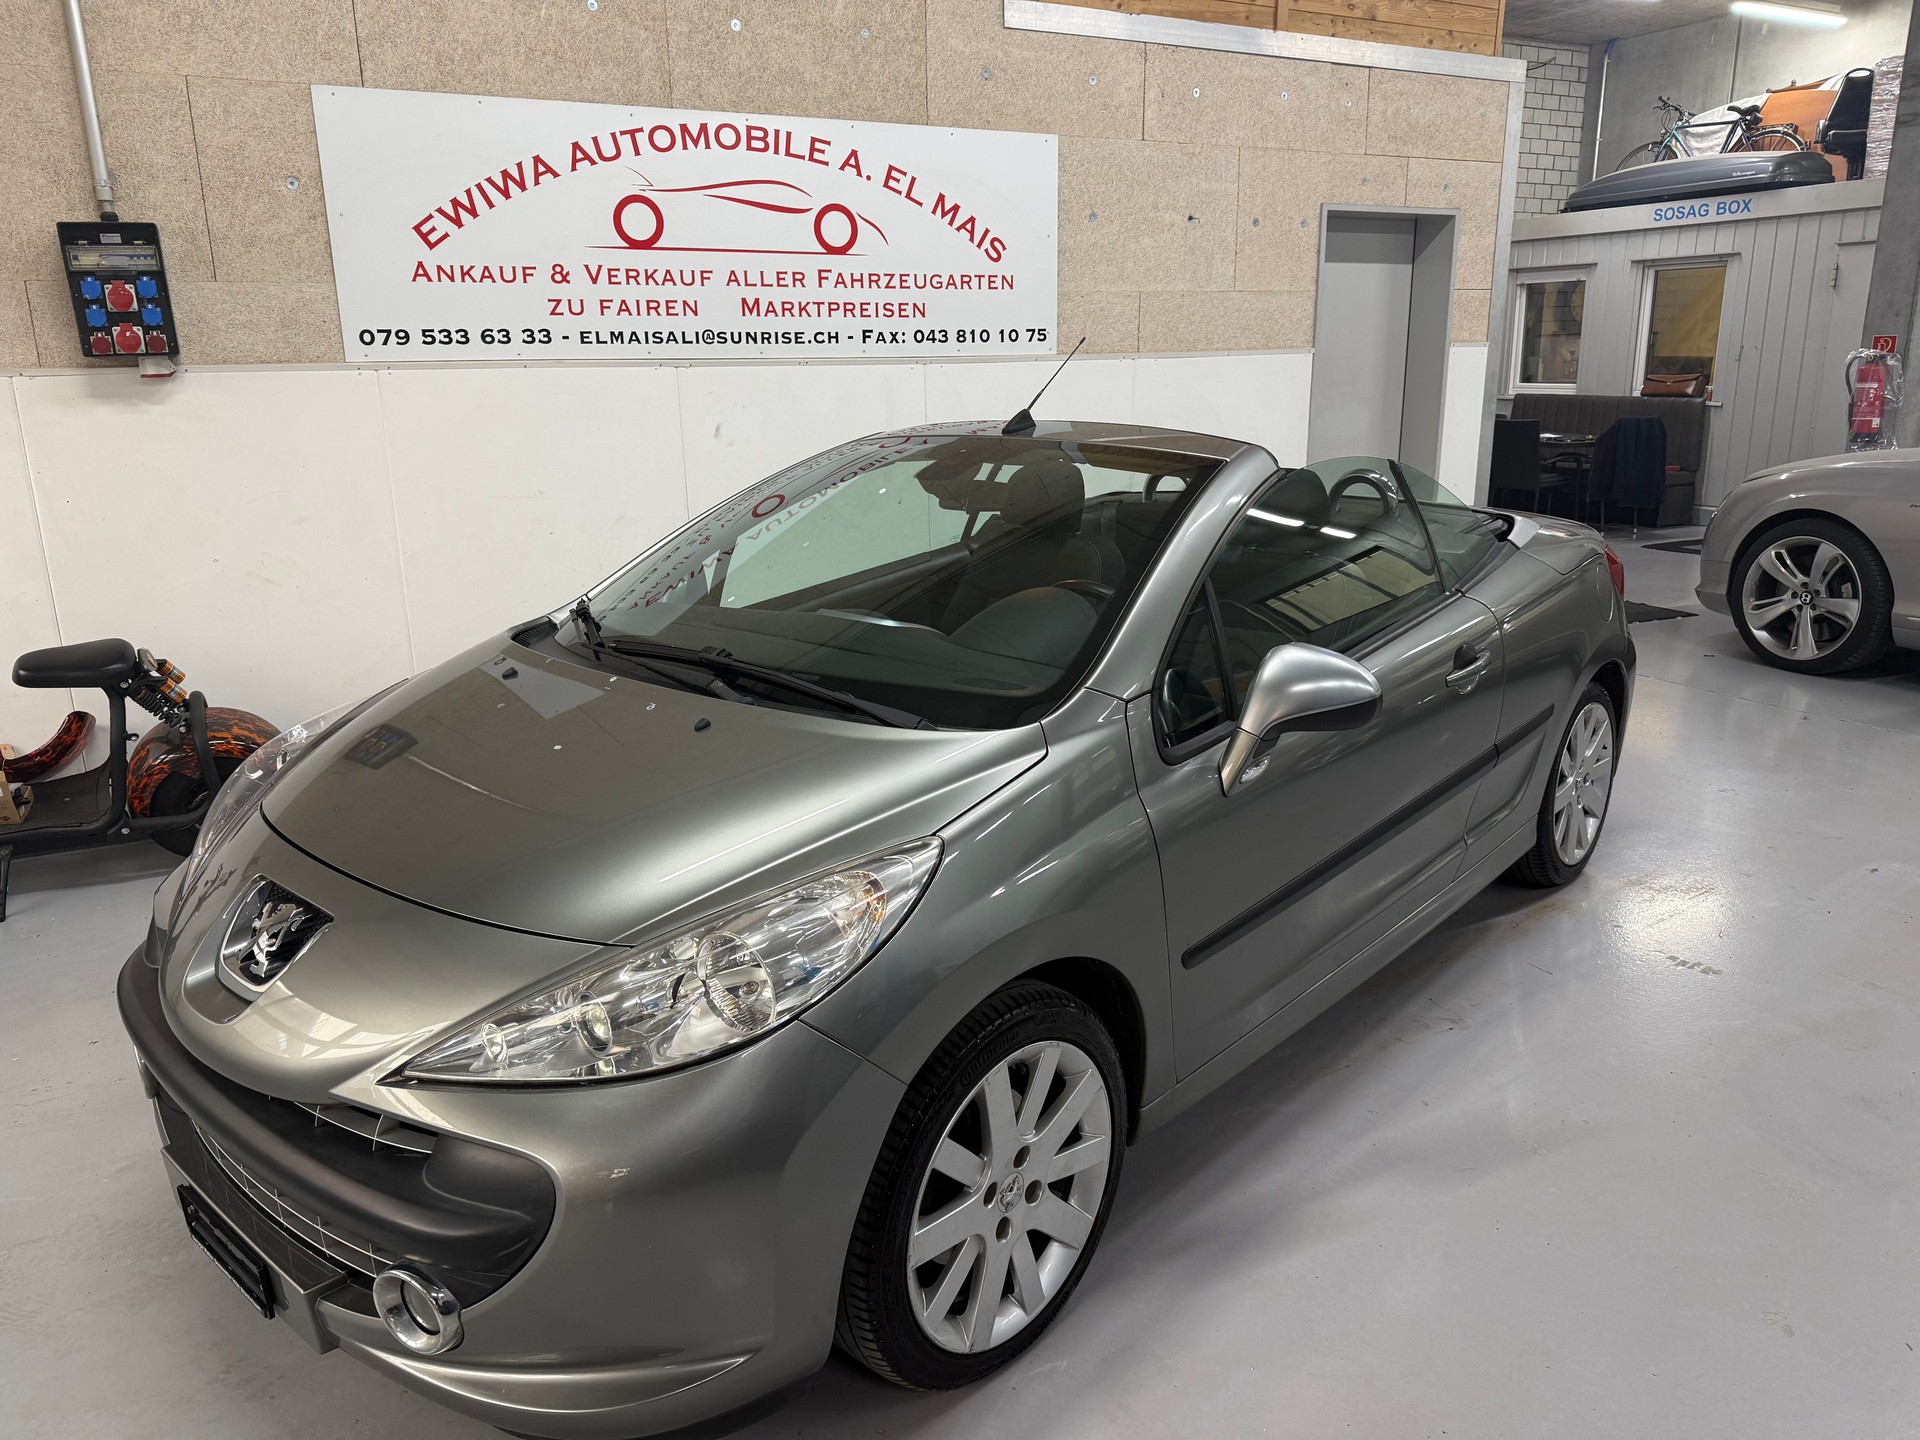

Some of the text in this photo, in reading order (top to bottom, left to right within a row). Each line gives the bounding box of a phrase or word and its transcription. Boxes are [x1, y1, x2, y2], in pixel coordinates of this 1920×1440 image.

[411, 122, 1008, 264] EWIWA AUTOMOBILE A. EL MAIS
[1653, 198, 1753, 222] SOSAG BOX
[411, 261, 1015, 291] ANKAUF & VERKAUF ALLER FAHRZEUGARTEN
[548, 297, 927, 319] ZU FAIREN MARKTPREISEN
[358, 328, 411, 346] 079
[421, 328, 470, 346] 533
[480, 328, 512, 345] 63
[521, 328, 552, 345] 33
[579, 329, 839, 345] ELMAISALI@SUNRISE.CH
[861, 329, 906, 344] FAX:
[913, 329, 949, 344] 043
[956, 329, 991, 344] 810
[998, 328, 1019, 343] 10
[1025, 328, 1047, 342] 75
